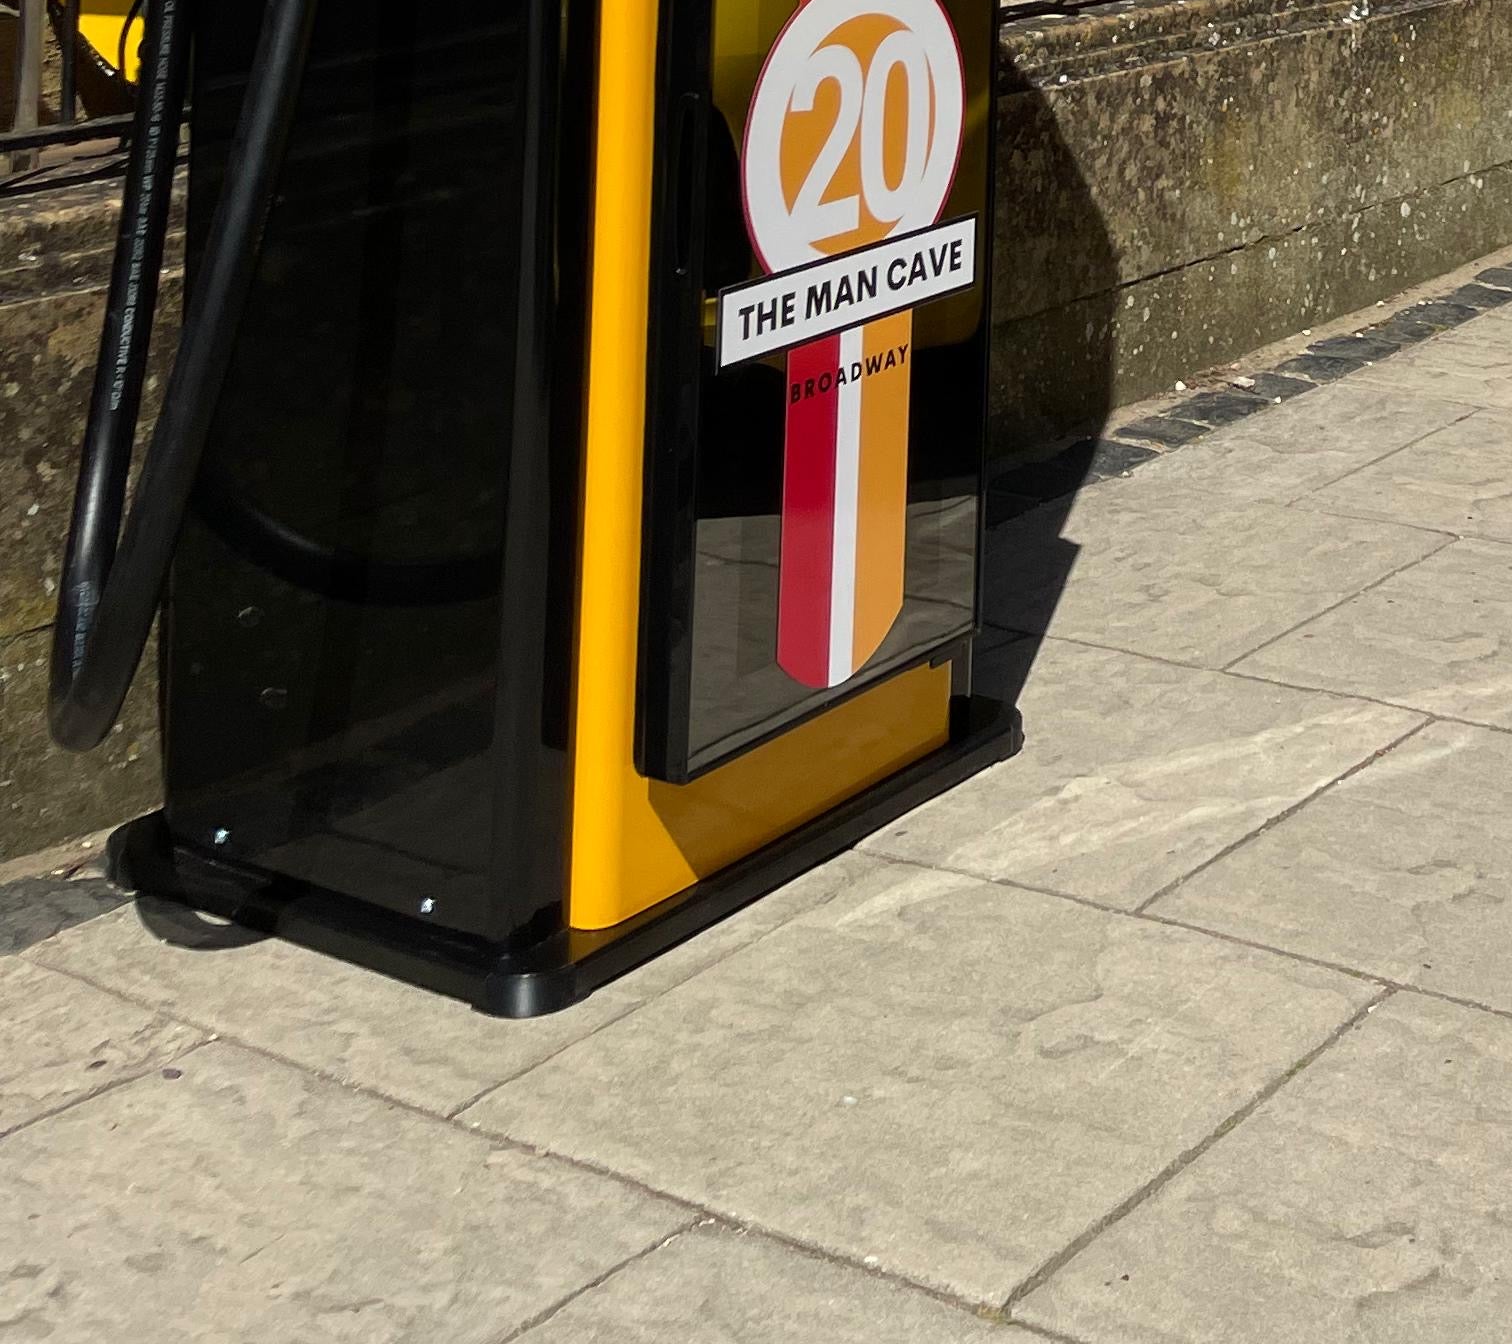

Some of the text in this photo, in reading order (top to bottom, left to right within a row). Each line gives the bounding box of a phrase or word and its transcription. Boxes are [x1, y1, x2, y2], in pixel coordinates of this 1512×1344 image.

[788, 27, 931, 239] 20
[738, 238, 963, 340] THE MAN CAVE
[789, 343, 910, 404] BROADWAY
